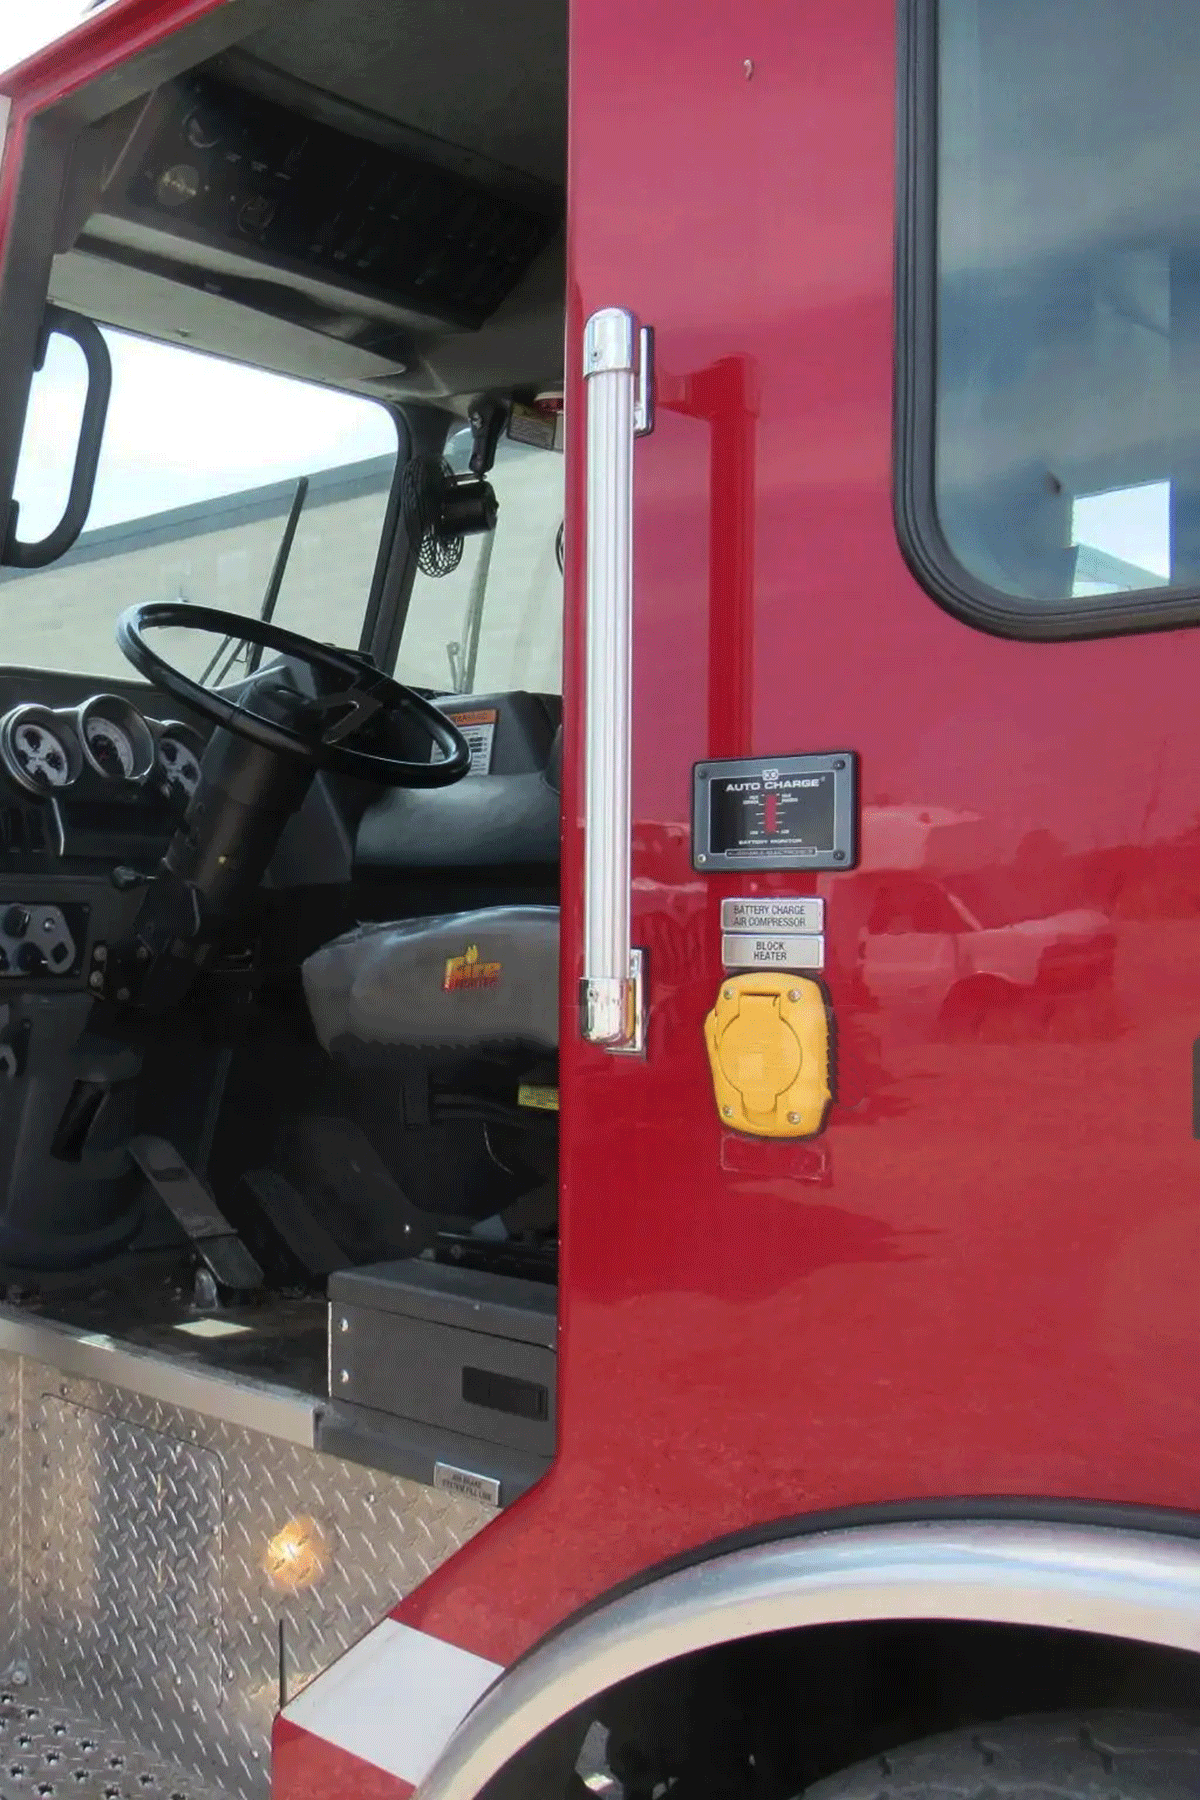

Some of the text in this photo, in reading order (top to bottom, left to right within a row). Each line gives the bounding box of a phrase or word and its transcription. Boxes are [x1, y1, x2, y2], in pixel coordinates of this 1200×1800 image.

[725, 778, 820, 792] AUTO CHARGE
[733, 905, 806, 915] BATTERY CHARGE
[732, 917, 806, 927] AIR COMPRESSOR
[755, 941, 785, 951] BLOCK
[753, 951, 787, 961] HEATER
